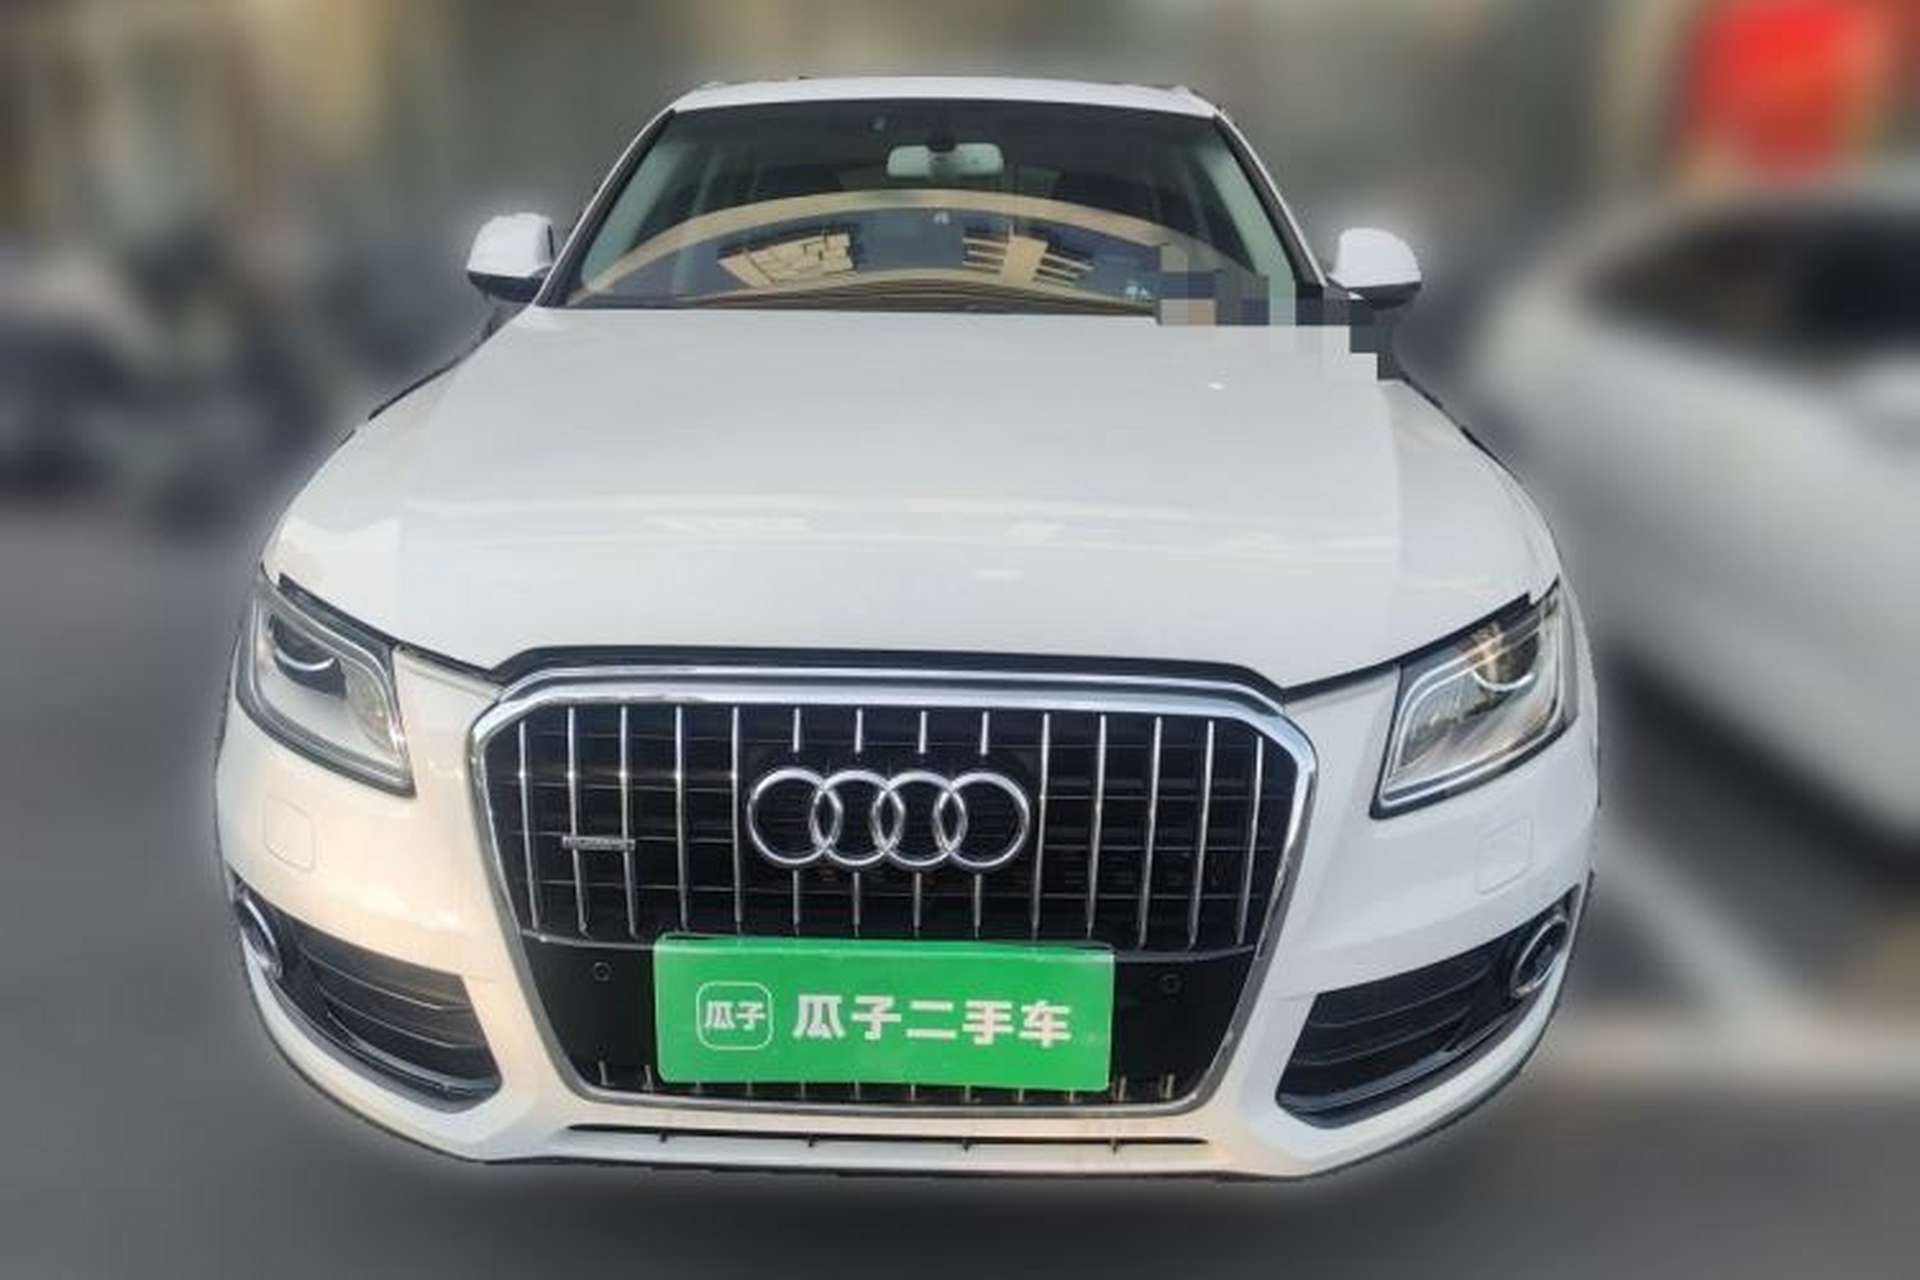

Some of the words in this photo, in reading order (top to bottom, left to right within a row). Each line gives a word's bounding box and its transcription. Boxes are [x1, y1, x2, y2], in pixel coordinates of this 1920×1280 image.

[704, 999, 766, 1030] 瓜子
[792, 993, 1072, 1048] 瓜子二手车
